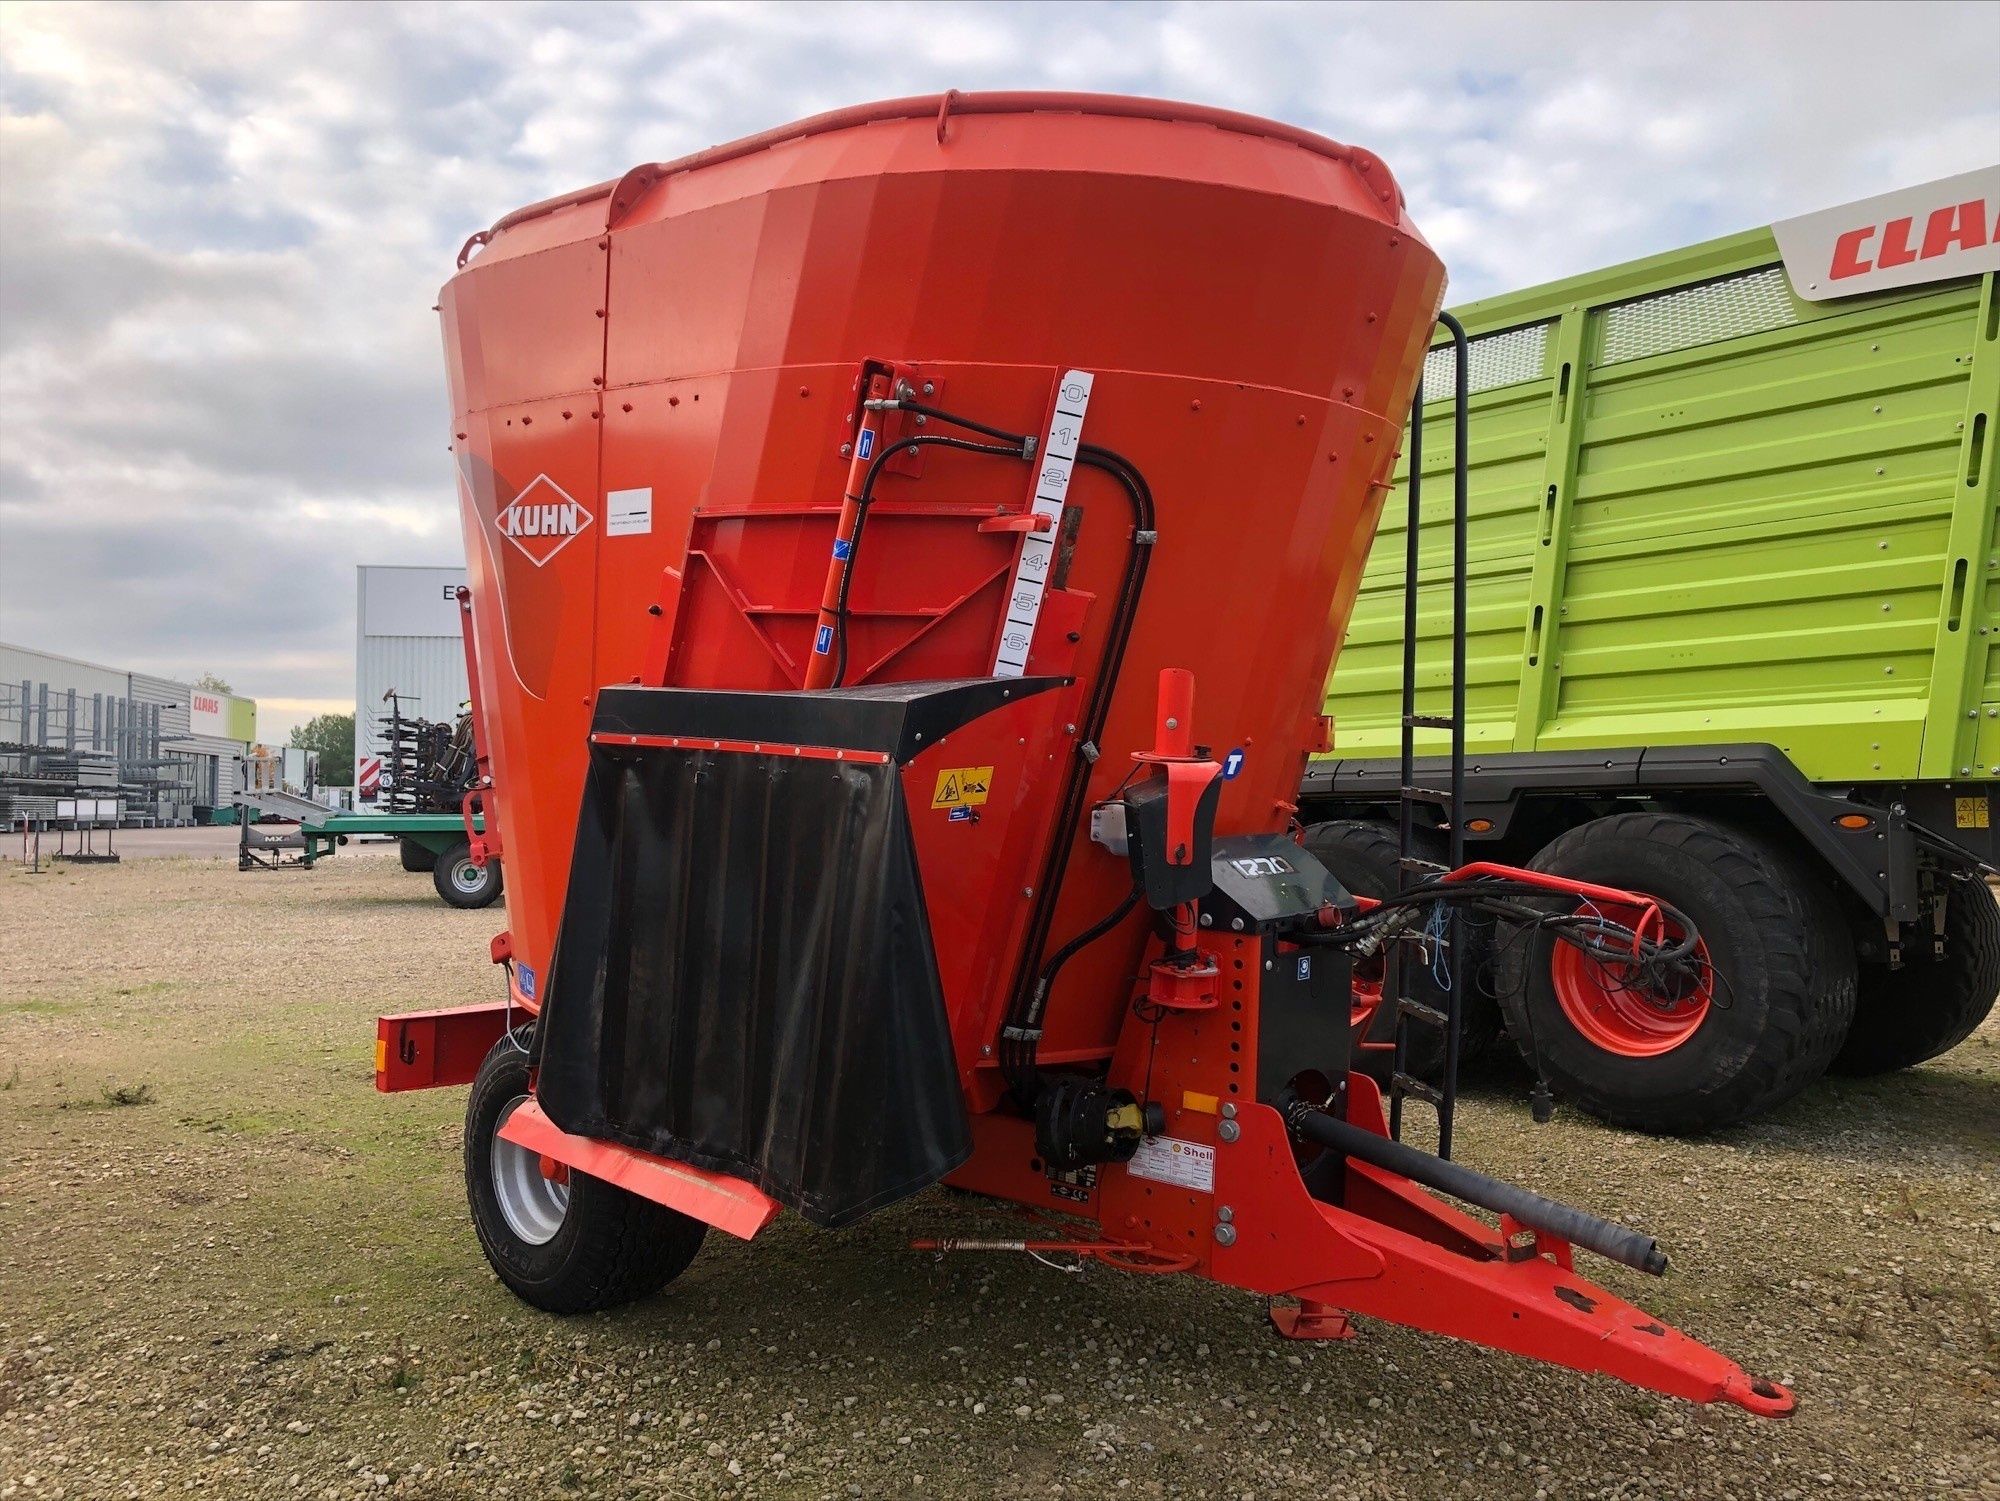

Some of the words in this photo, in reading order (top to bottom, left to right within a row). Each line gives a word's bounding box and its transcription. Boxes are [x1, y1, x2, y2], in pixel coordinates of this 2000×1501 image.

[1829, 198, 2000, 281] CLA
[1064, 383, 1085, 403] 0
[1059, 427, 1072, 446] 1
[1043, 468, 1065, 488] 2
[507, 503, 577, 537] KUHN
[1025, 553, 1044, 572] 4
[1015, 592, 1036, 612] 5
[1005, 632, 1026, 651] 6
[1227, 754, 1242, 775] T
[1183, 1146, 1213, 1160] Shell
